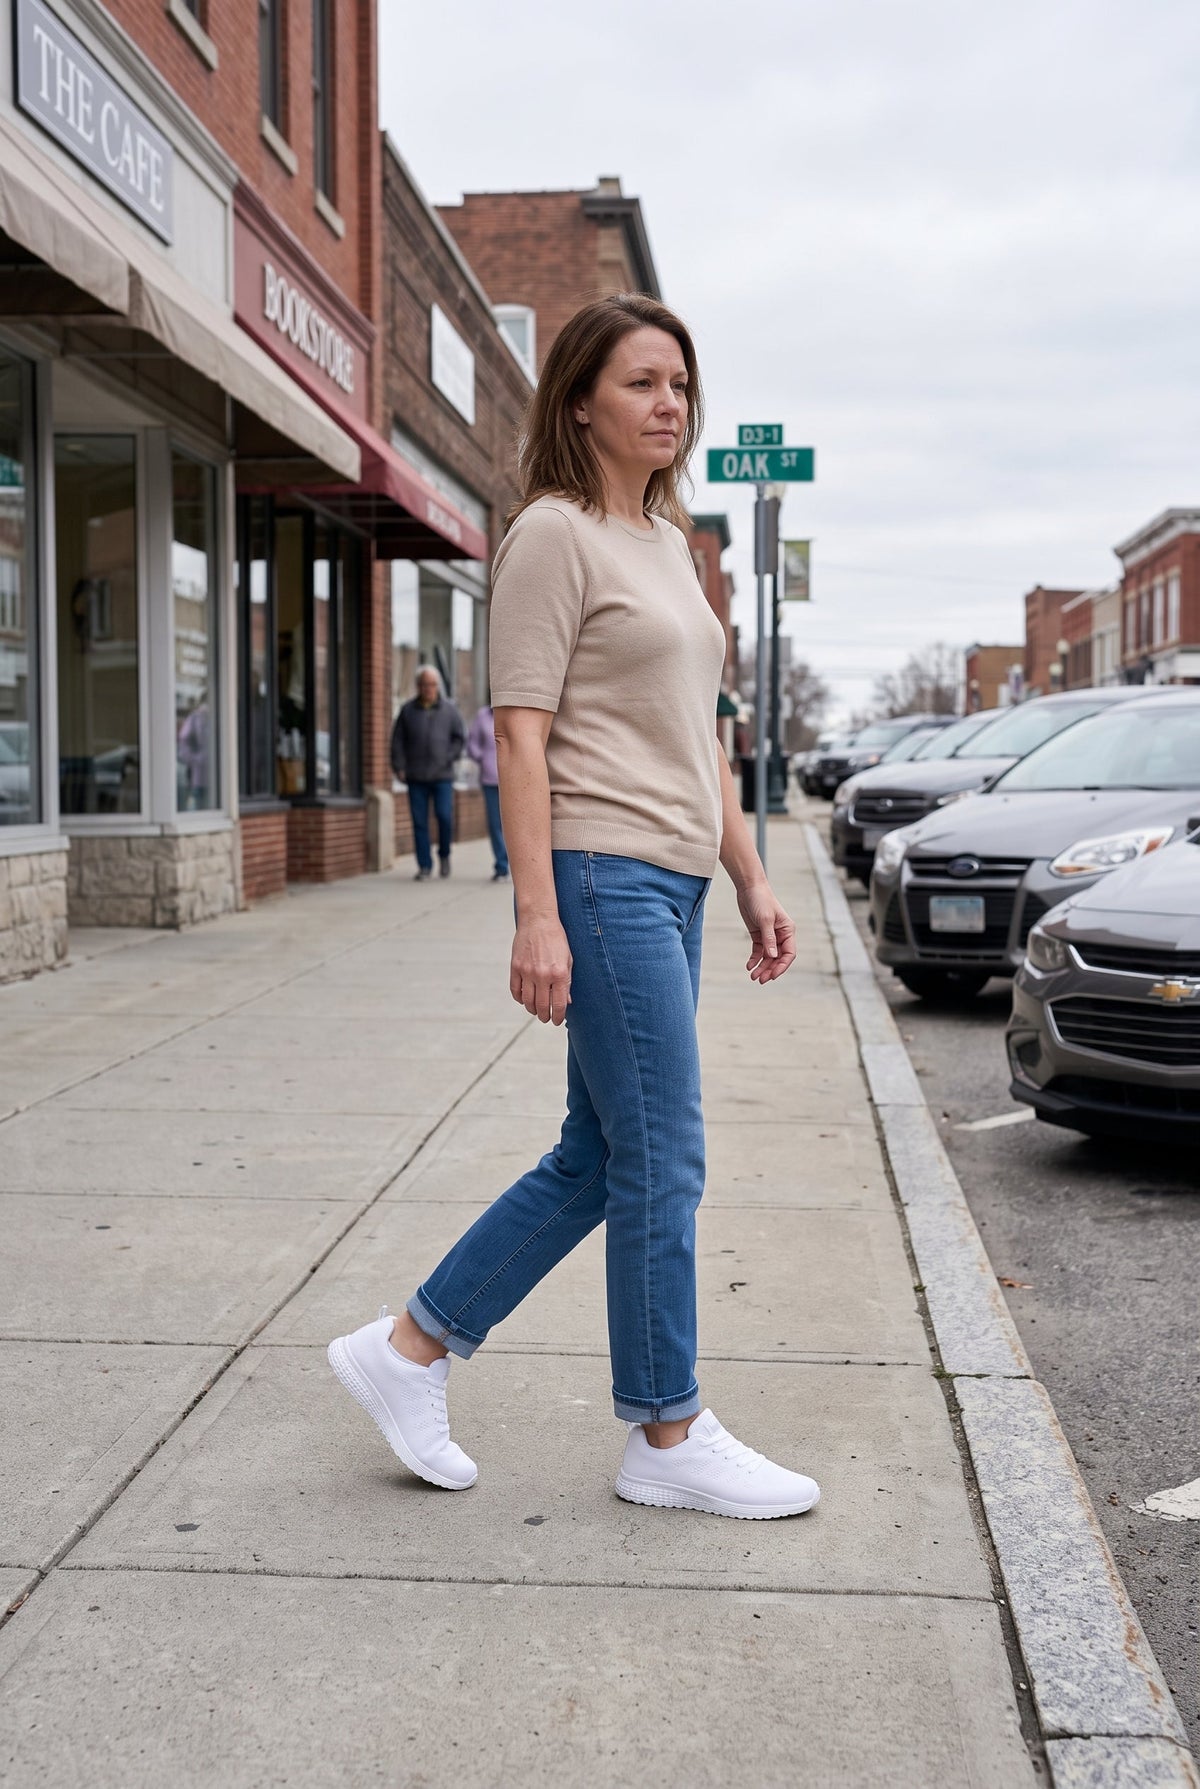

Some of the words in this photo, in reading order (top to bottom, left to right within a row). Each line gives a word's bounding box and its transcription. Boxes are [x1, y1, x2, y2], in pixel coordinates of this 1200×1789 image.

[33, 23, 95, 145] THE
[100, 101, 164, 213] CAFE
[264, 261, 354, 393] BOOKSTORE
[722, 452, 770, 479] OAK
[780, 452, 798, 467] ST
[742, 427, 779, 444] D3-1
